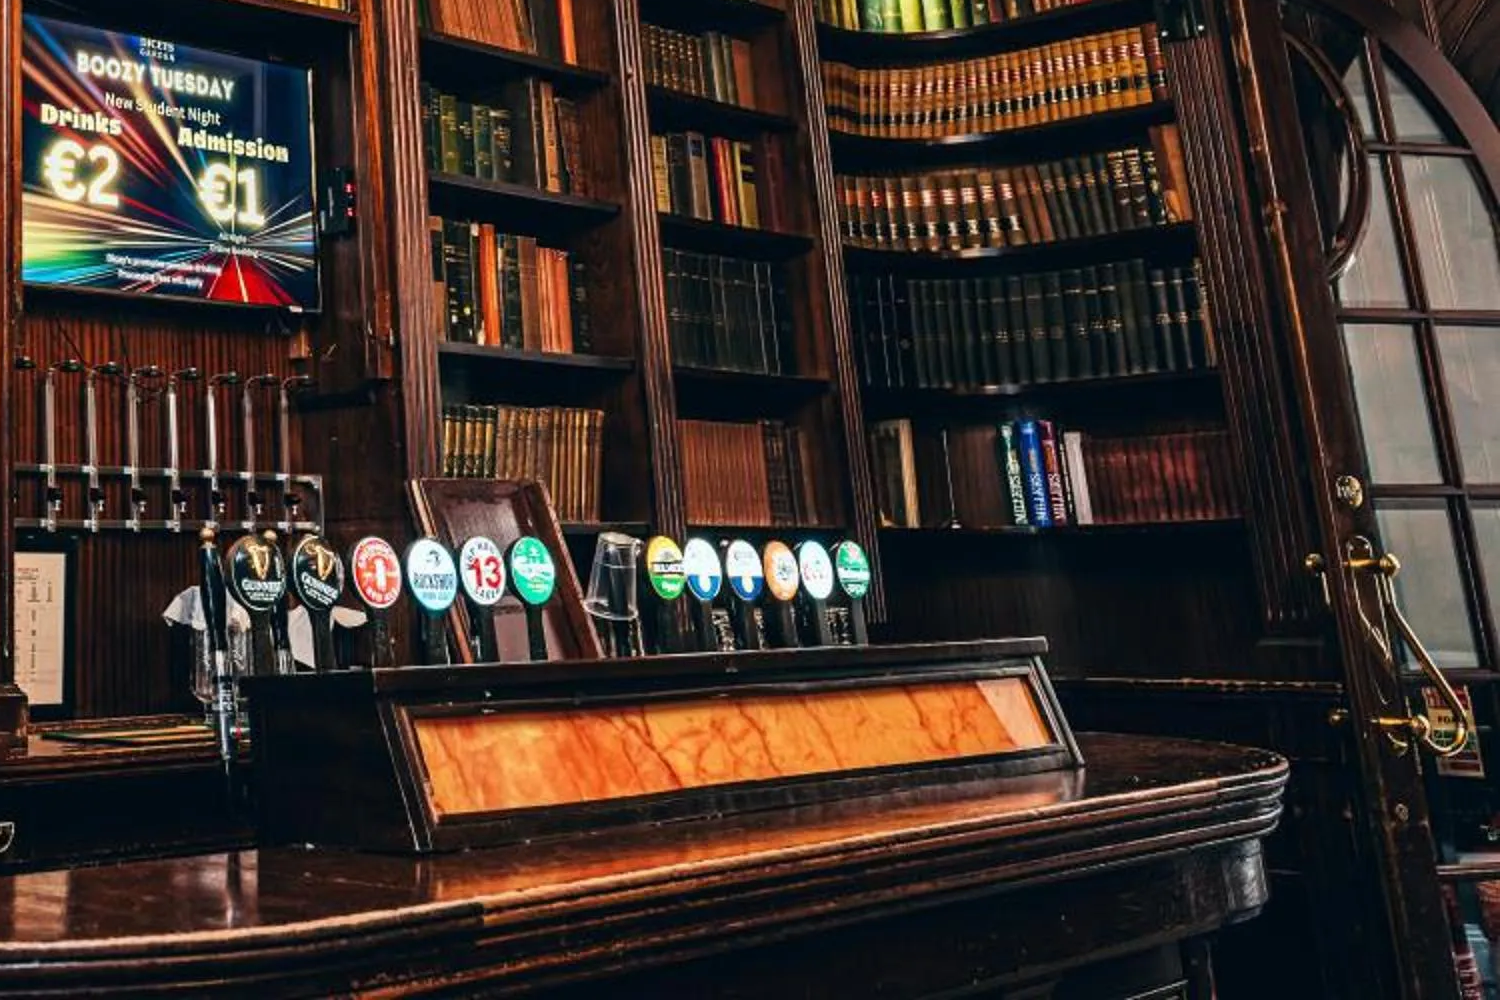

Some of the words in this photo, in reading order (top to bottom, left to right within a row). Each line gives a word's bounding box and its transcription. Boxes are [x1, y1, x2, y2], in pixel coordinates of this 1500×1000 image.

[75, 50, 144, 83] BOOZY
[151, 66, 235, 101] TUESDAY
[39, 102, 123, 136] Drinks
[104, 91, 133, 110] New
[187, 106, 221, 127] Night
[177, 126, 290, 163] Admission
[43, 140, 120, 206] €2
[199, 163, 266, 227] €1
[472, 556, 502, 588] 13
